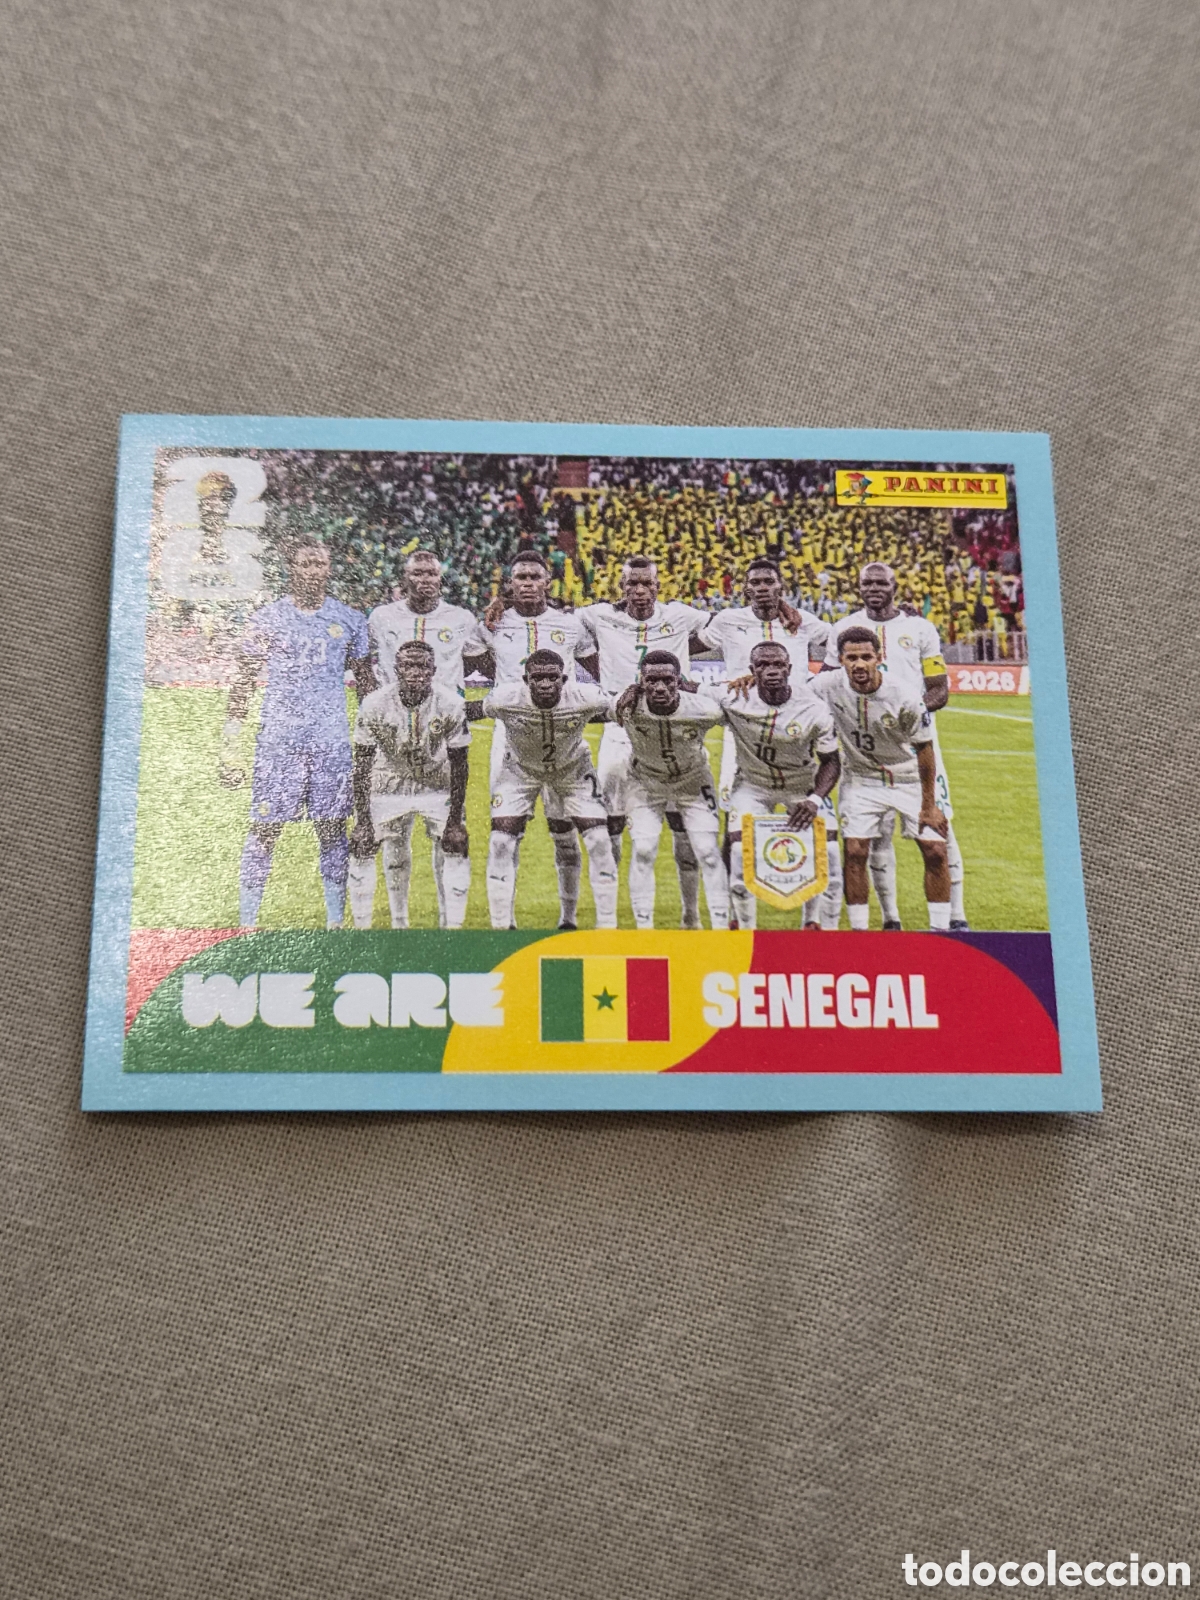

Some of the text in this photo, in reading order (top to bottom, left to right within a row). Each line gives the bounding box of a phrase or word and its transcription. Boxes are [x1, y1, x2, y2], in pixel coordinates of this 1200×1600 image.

[884, 477, 999, 494] PANINI
[635, 645, 648, 670] 7
[851, 731, 875, 752] 13
[542, 744, 556, 762] 2
[754, 743, 776, 762] 10
[701, 785, 717, 810] 5
[182, 971, 939, 1029] WE ARE SENEGAL
